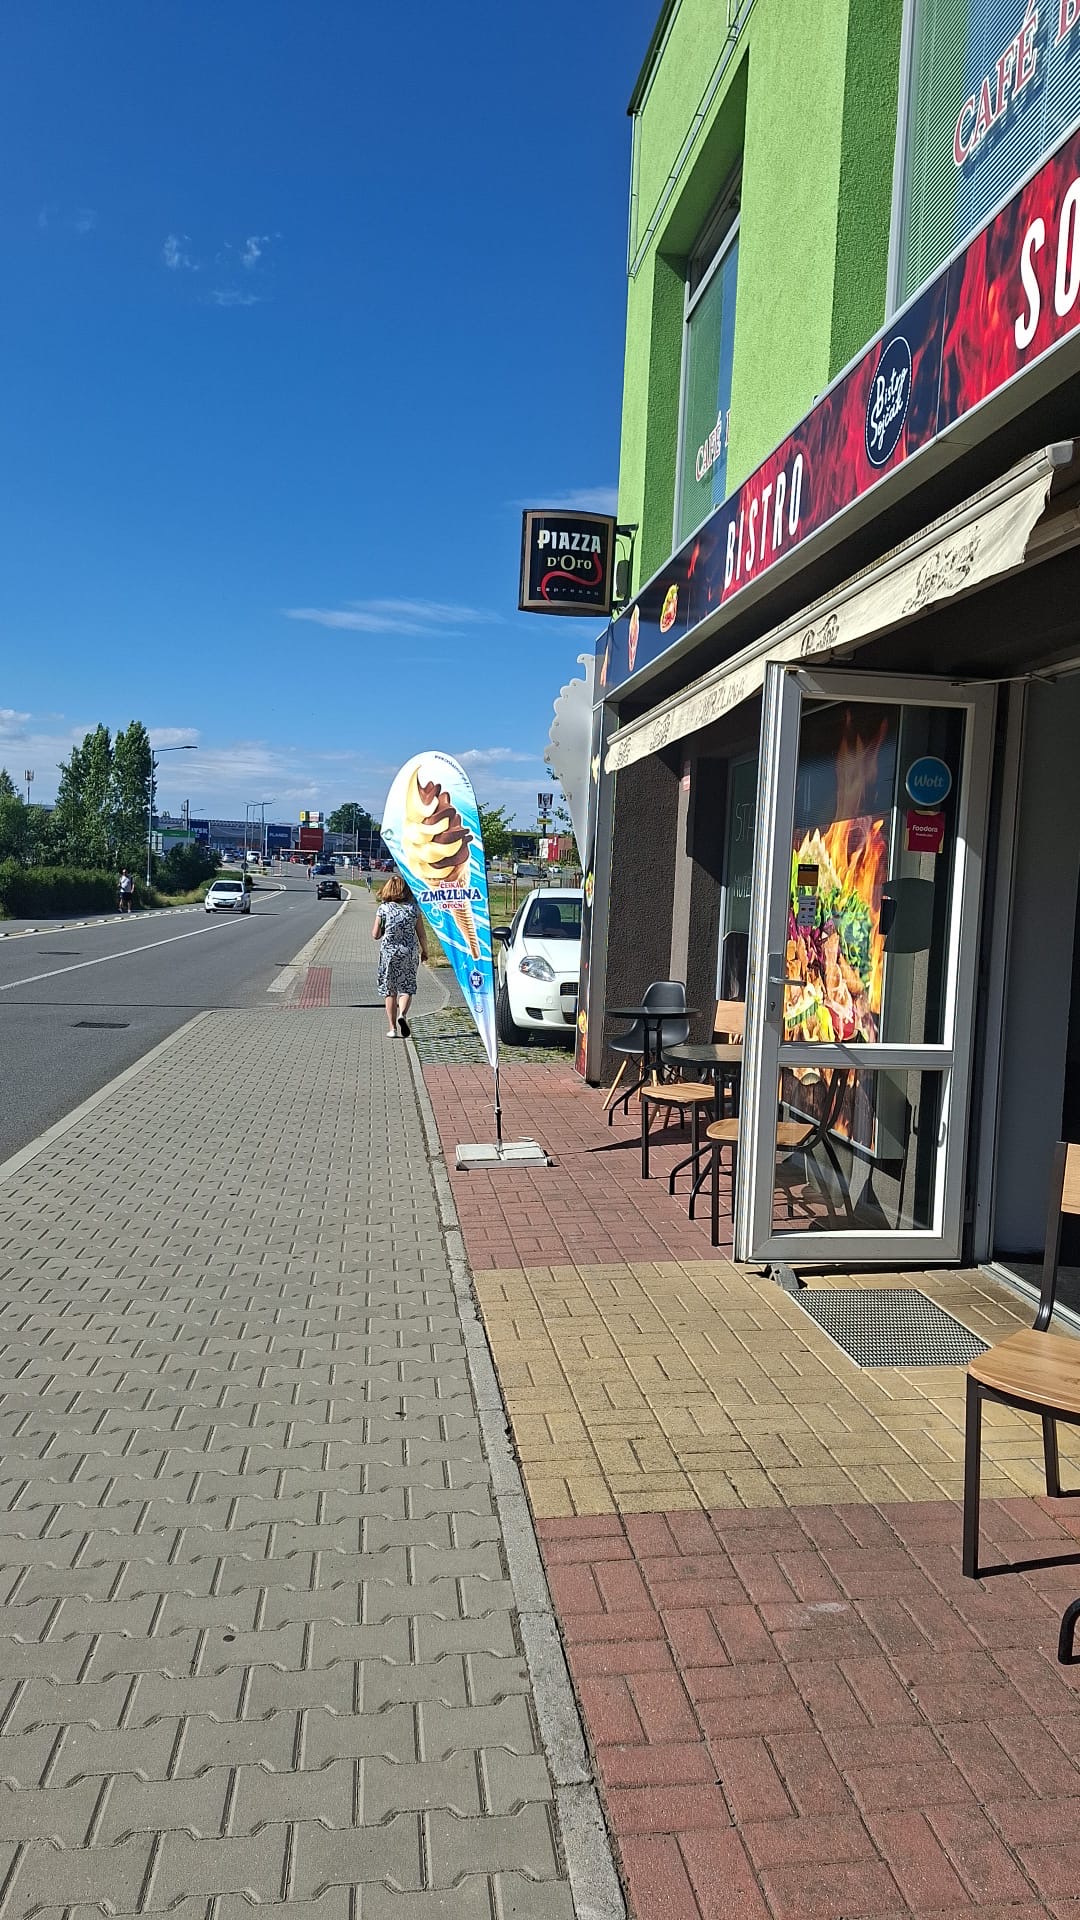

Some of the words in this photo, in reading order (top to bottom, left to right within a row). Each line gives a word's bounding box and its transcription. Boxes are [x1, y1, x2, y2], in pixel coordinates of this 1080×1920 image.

[953, 0, 1039, 167] CAFÉ
[875, 367, 909, 418] Bistro
[695, 410, 722, 482] CAFÉ
[537, 529, 601, 554] PIAZZA
[724, 453, 804, 590] BISTRO
[914, 773, 944, 788] Wolt
[420, 887, 482, 902] ZMRZLINA
